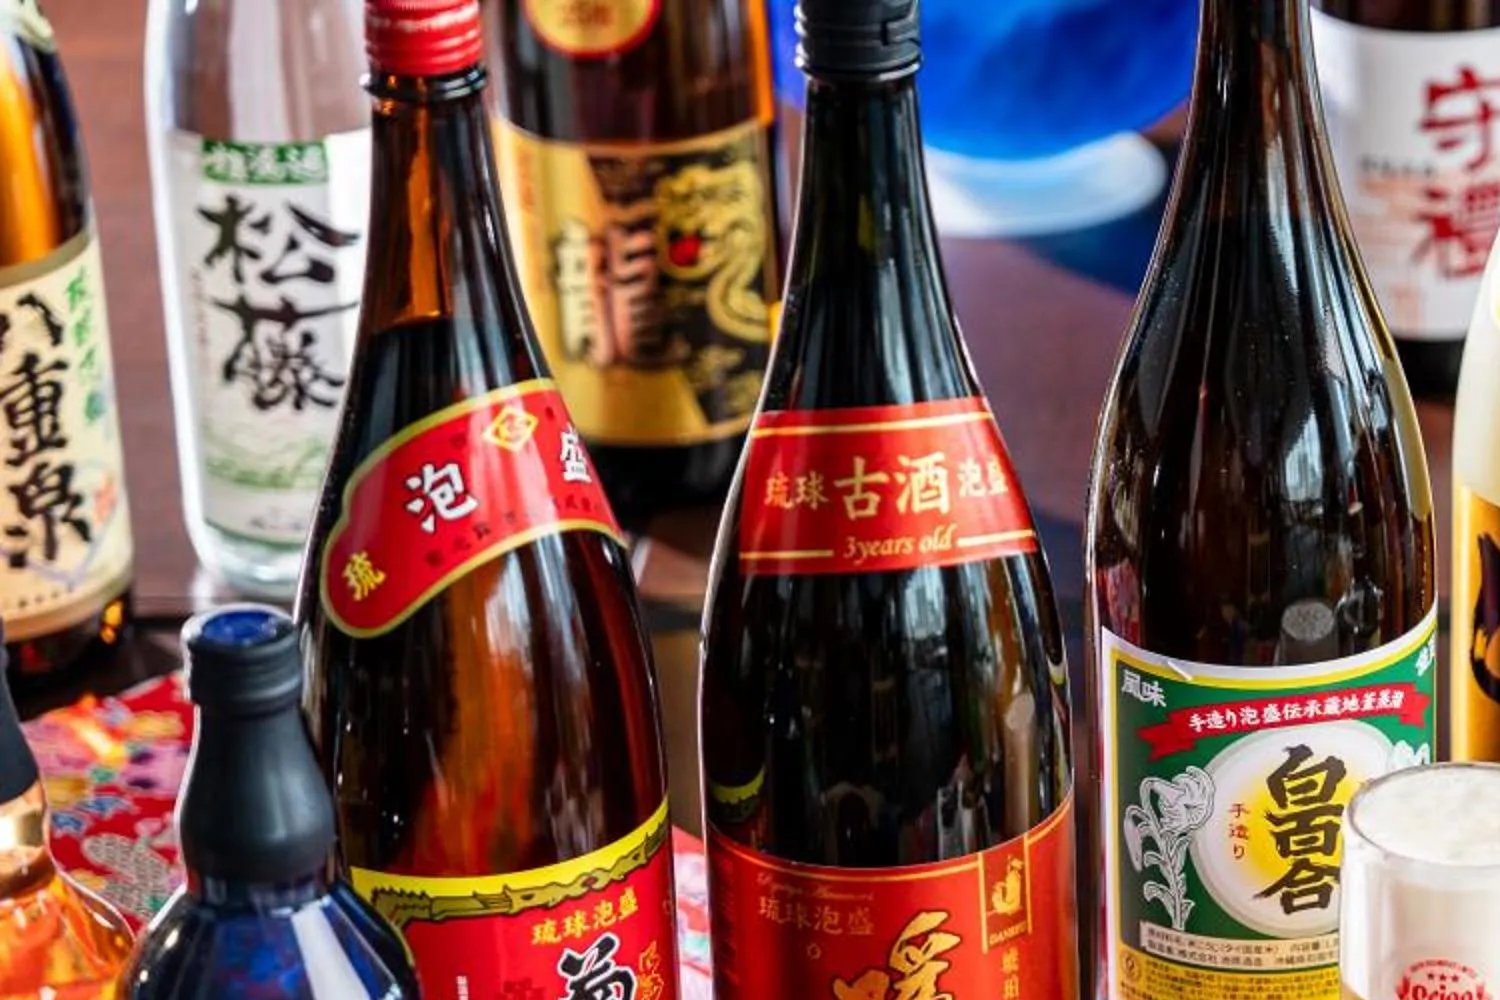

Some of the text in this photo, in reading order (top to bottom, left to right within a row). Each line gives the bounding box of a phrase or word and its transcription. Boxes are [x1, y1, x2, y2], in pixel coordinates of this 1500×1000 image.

[197, 193, 360, 411] 松藤
[764, 470, 829, 510] 琉球
[834, 450, 951, 521] 古酒
[1120, 668, 1167, 709] 風味
[1227, 803, 1251, 861] 手造り
[1251, 743, 1348, 916] 白百合
[530, 886, 640, 946] 琉球泡盛
